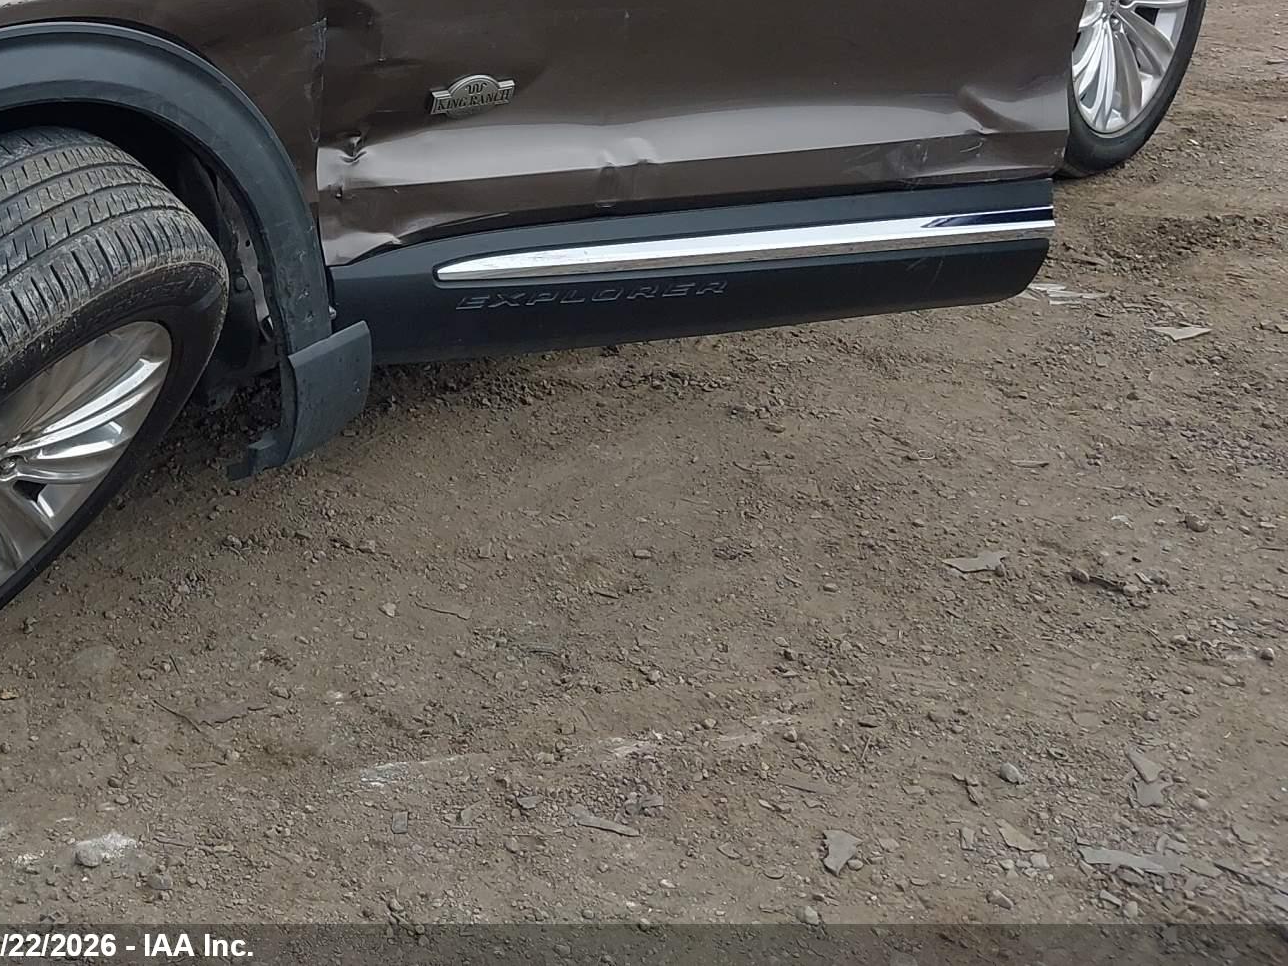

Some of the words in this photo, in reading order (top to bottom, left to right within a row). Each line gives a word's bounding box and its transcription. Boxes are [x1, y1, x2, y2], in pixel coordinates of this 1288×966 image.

[437, 96, 468, 111] KING
[470, 88, 511, 106] RANCH
[455, 281, 728, 310] EXPLORER
